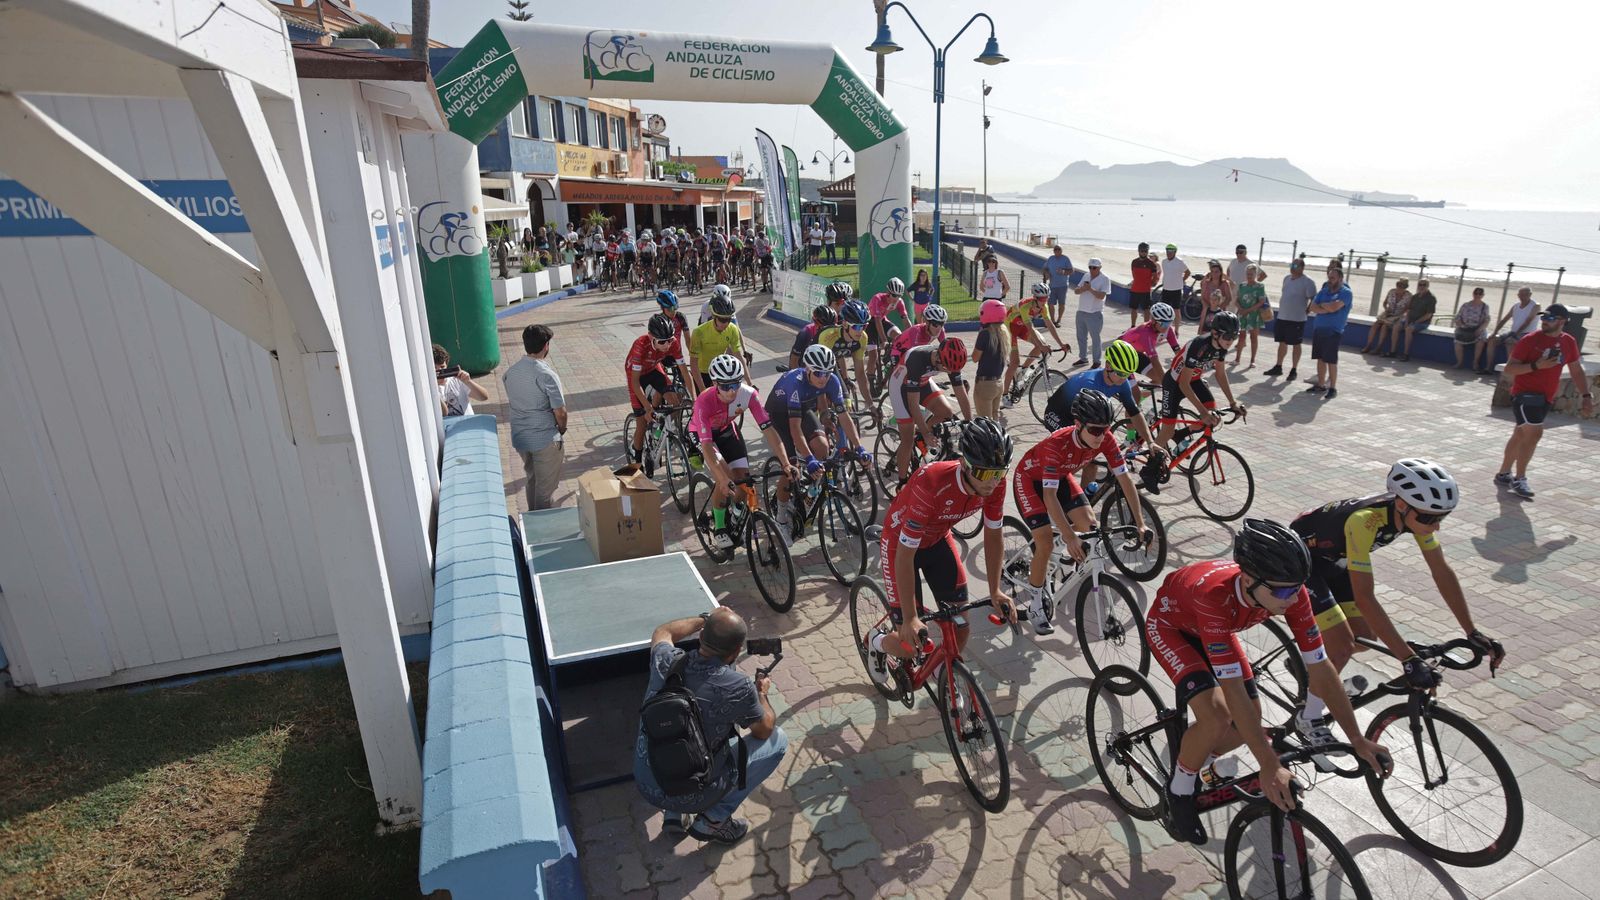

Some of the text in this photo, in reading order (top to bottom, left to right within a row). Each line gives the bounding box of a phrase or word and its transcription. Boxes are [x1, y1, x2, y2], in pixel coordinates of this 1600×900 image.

[665, 51, 743, 65] ANDALUZA
[684, 40, 770, 54] FEDERACIÓN
[444, 46, 499, 102] FEDERACIÓN
[463, 63, 517, 117] DE CICLISMO
[690, 67, 775, 81] DE CICLISMO
[834, 74, 874, 117] ANDALUZA
[839, 92, 885, 139] DE CICLISMO
[881, 537, 896, 603] TREBUJENA
[1147, 617, 1186, 675] TREBUJENA
